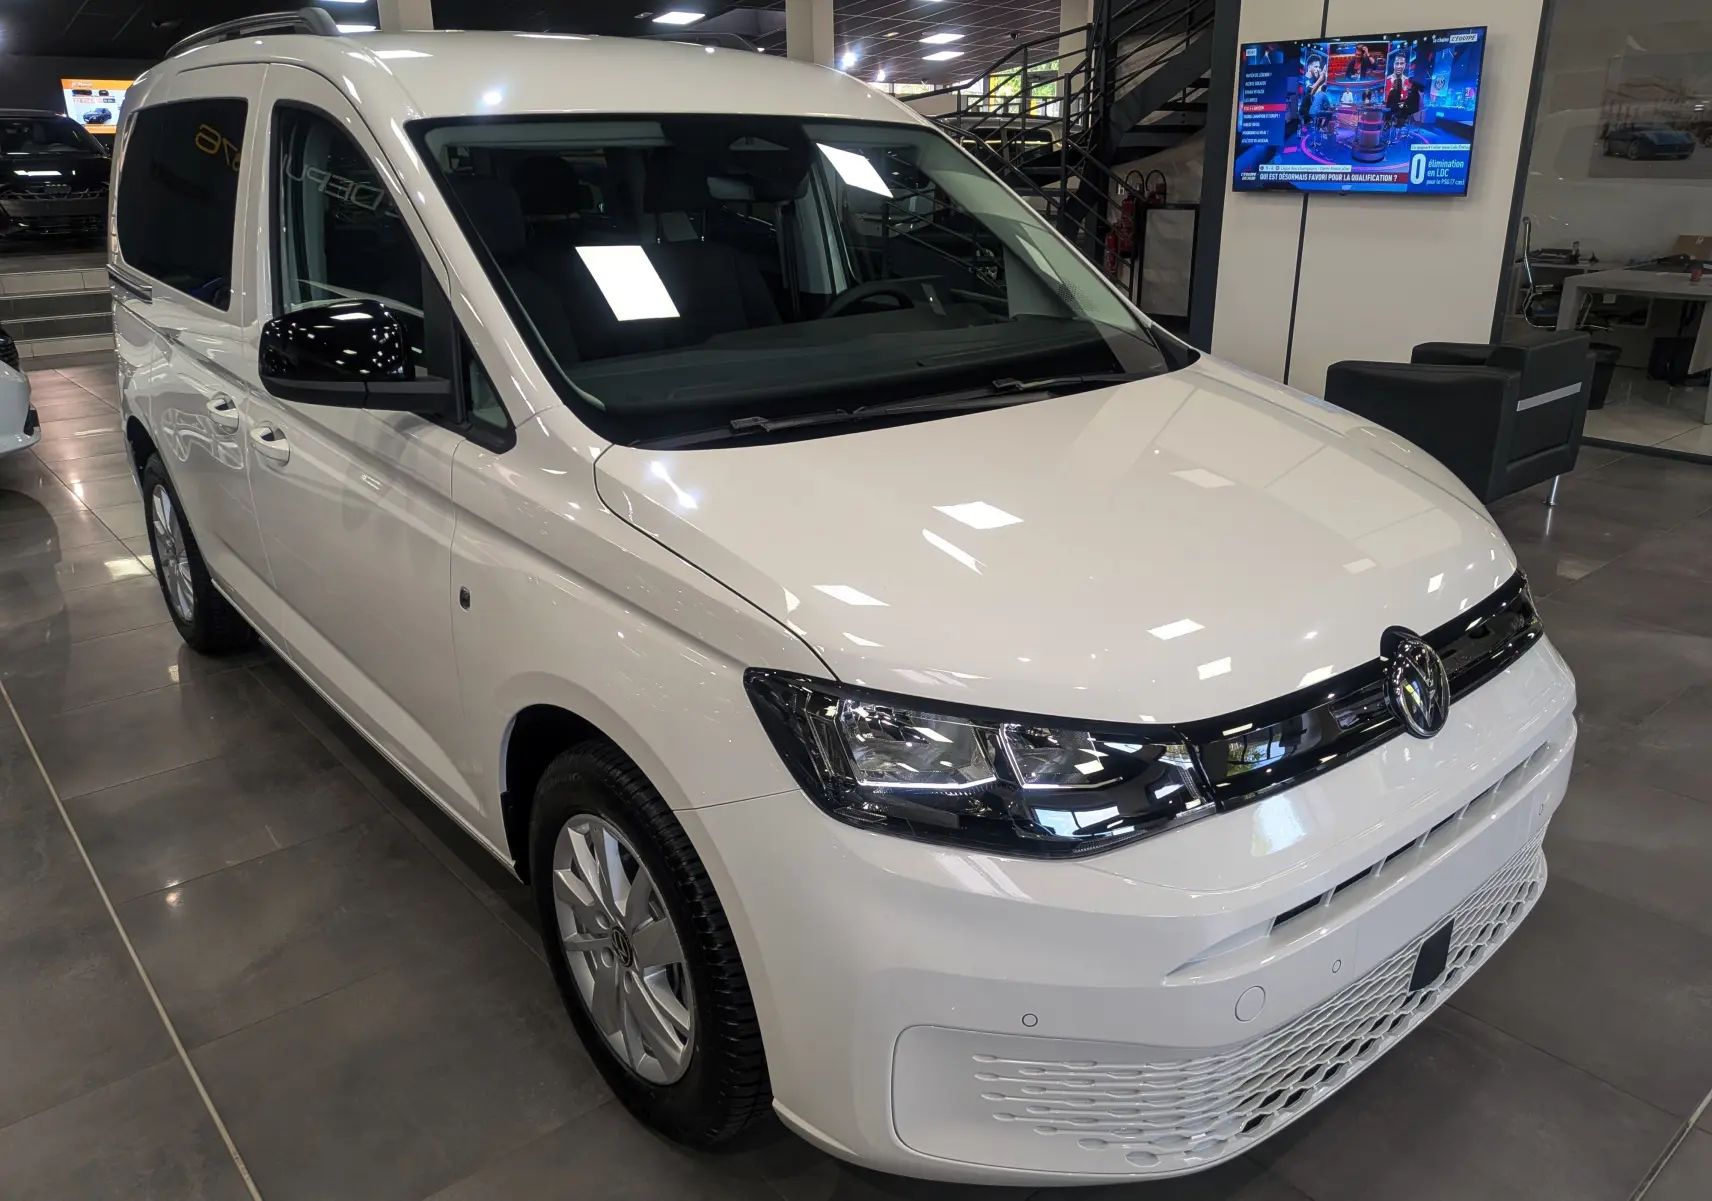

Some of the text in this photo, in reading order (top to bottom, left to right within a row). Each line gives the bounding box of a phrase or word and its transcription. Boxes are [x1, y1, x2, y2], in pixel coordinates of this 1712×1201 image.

[1428, 159, 1464, 168] élimination
[1411, 153, 1426, 184] 0
[1436, 168, 1449, 177] LDC
[1279, 171, 1308, 180] DÉSORMAIS
